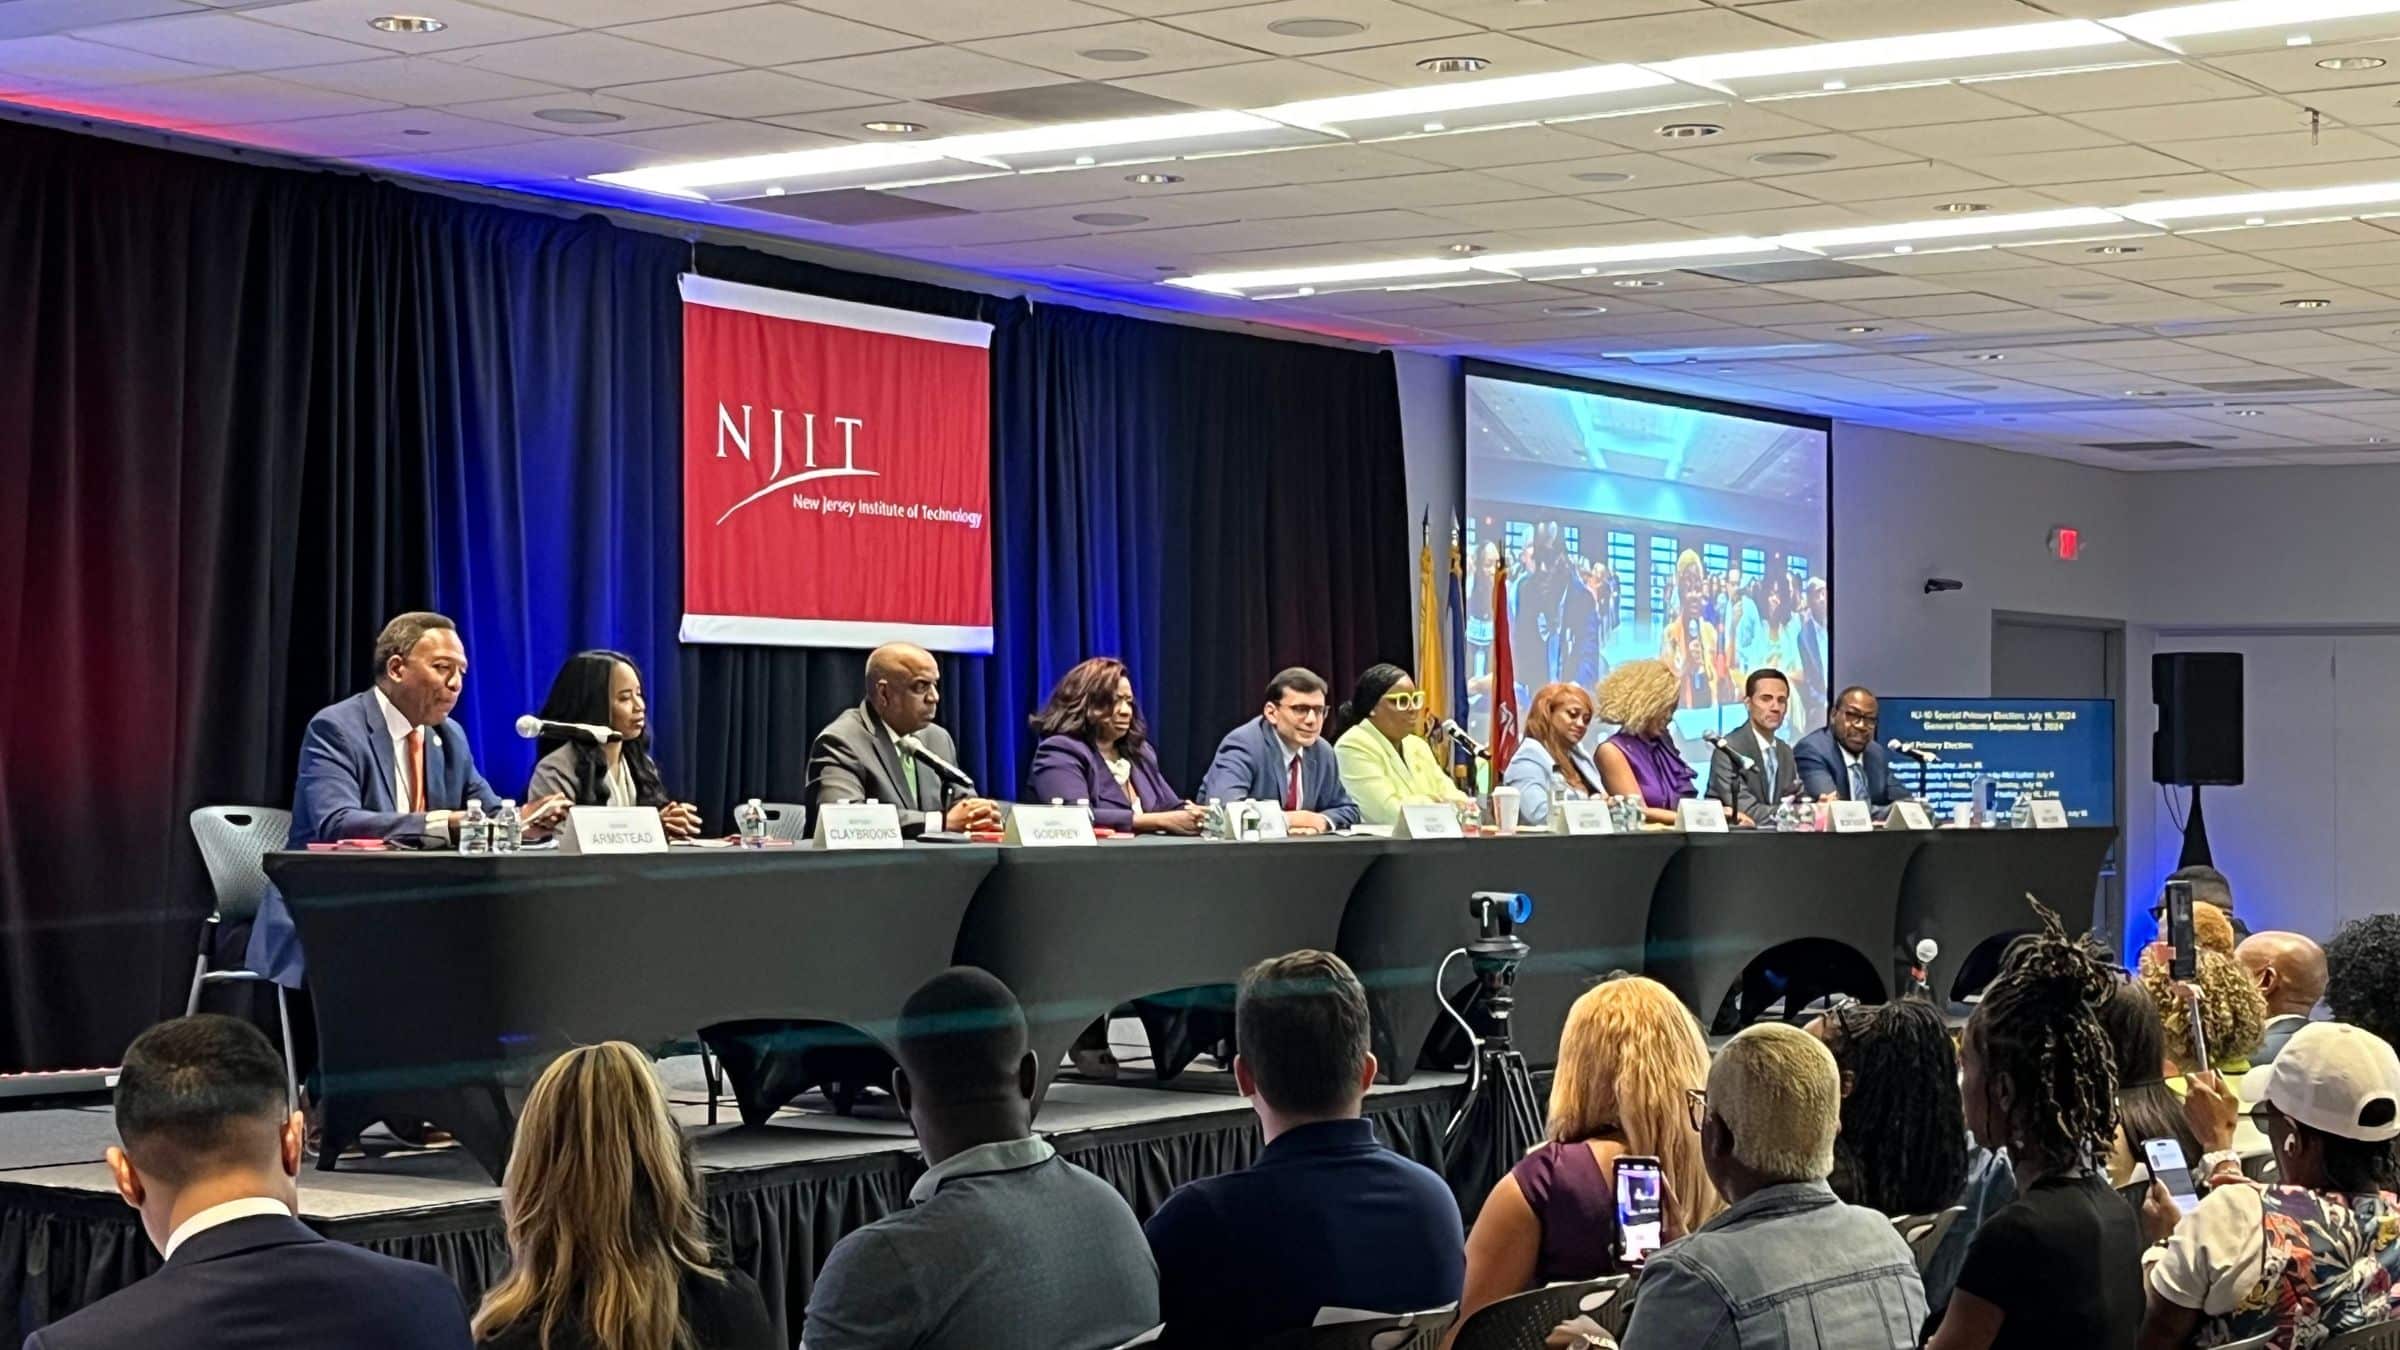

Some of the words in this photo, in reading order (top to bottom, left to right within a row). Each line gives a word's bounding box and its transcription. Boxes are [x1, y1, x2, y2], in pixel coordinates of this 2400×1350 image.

[716, 400, 863, 481] NJIT
[793, 493, 820, 511] New
[822, 496, 855, 518] Jersey
[858, 499, 905, 518] Institute
[907, 503, 919, 519] of
[922, 505, 983, 529] Technology
[1963, 711, 1992, 722] Primary
[592, 832, 653, 845] ARMSTEAD
[830, 828, 897, 841] CLAYBROOKS
